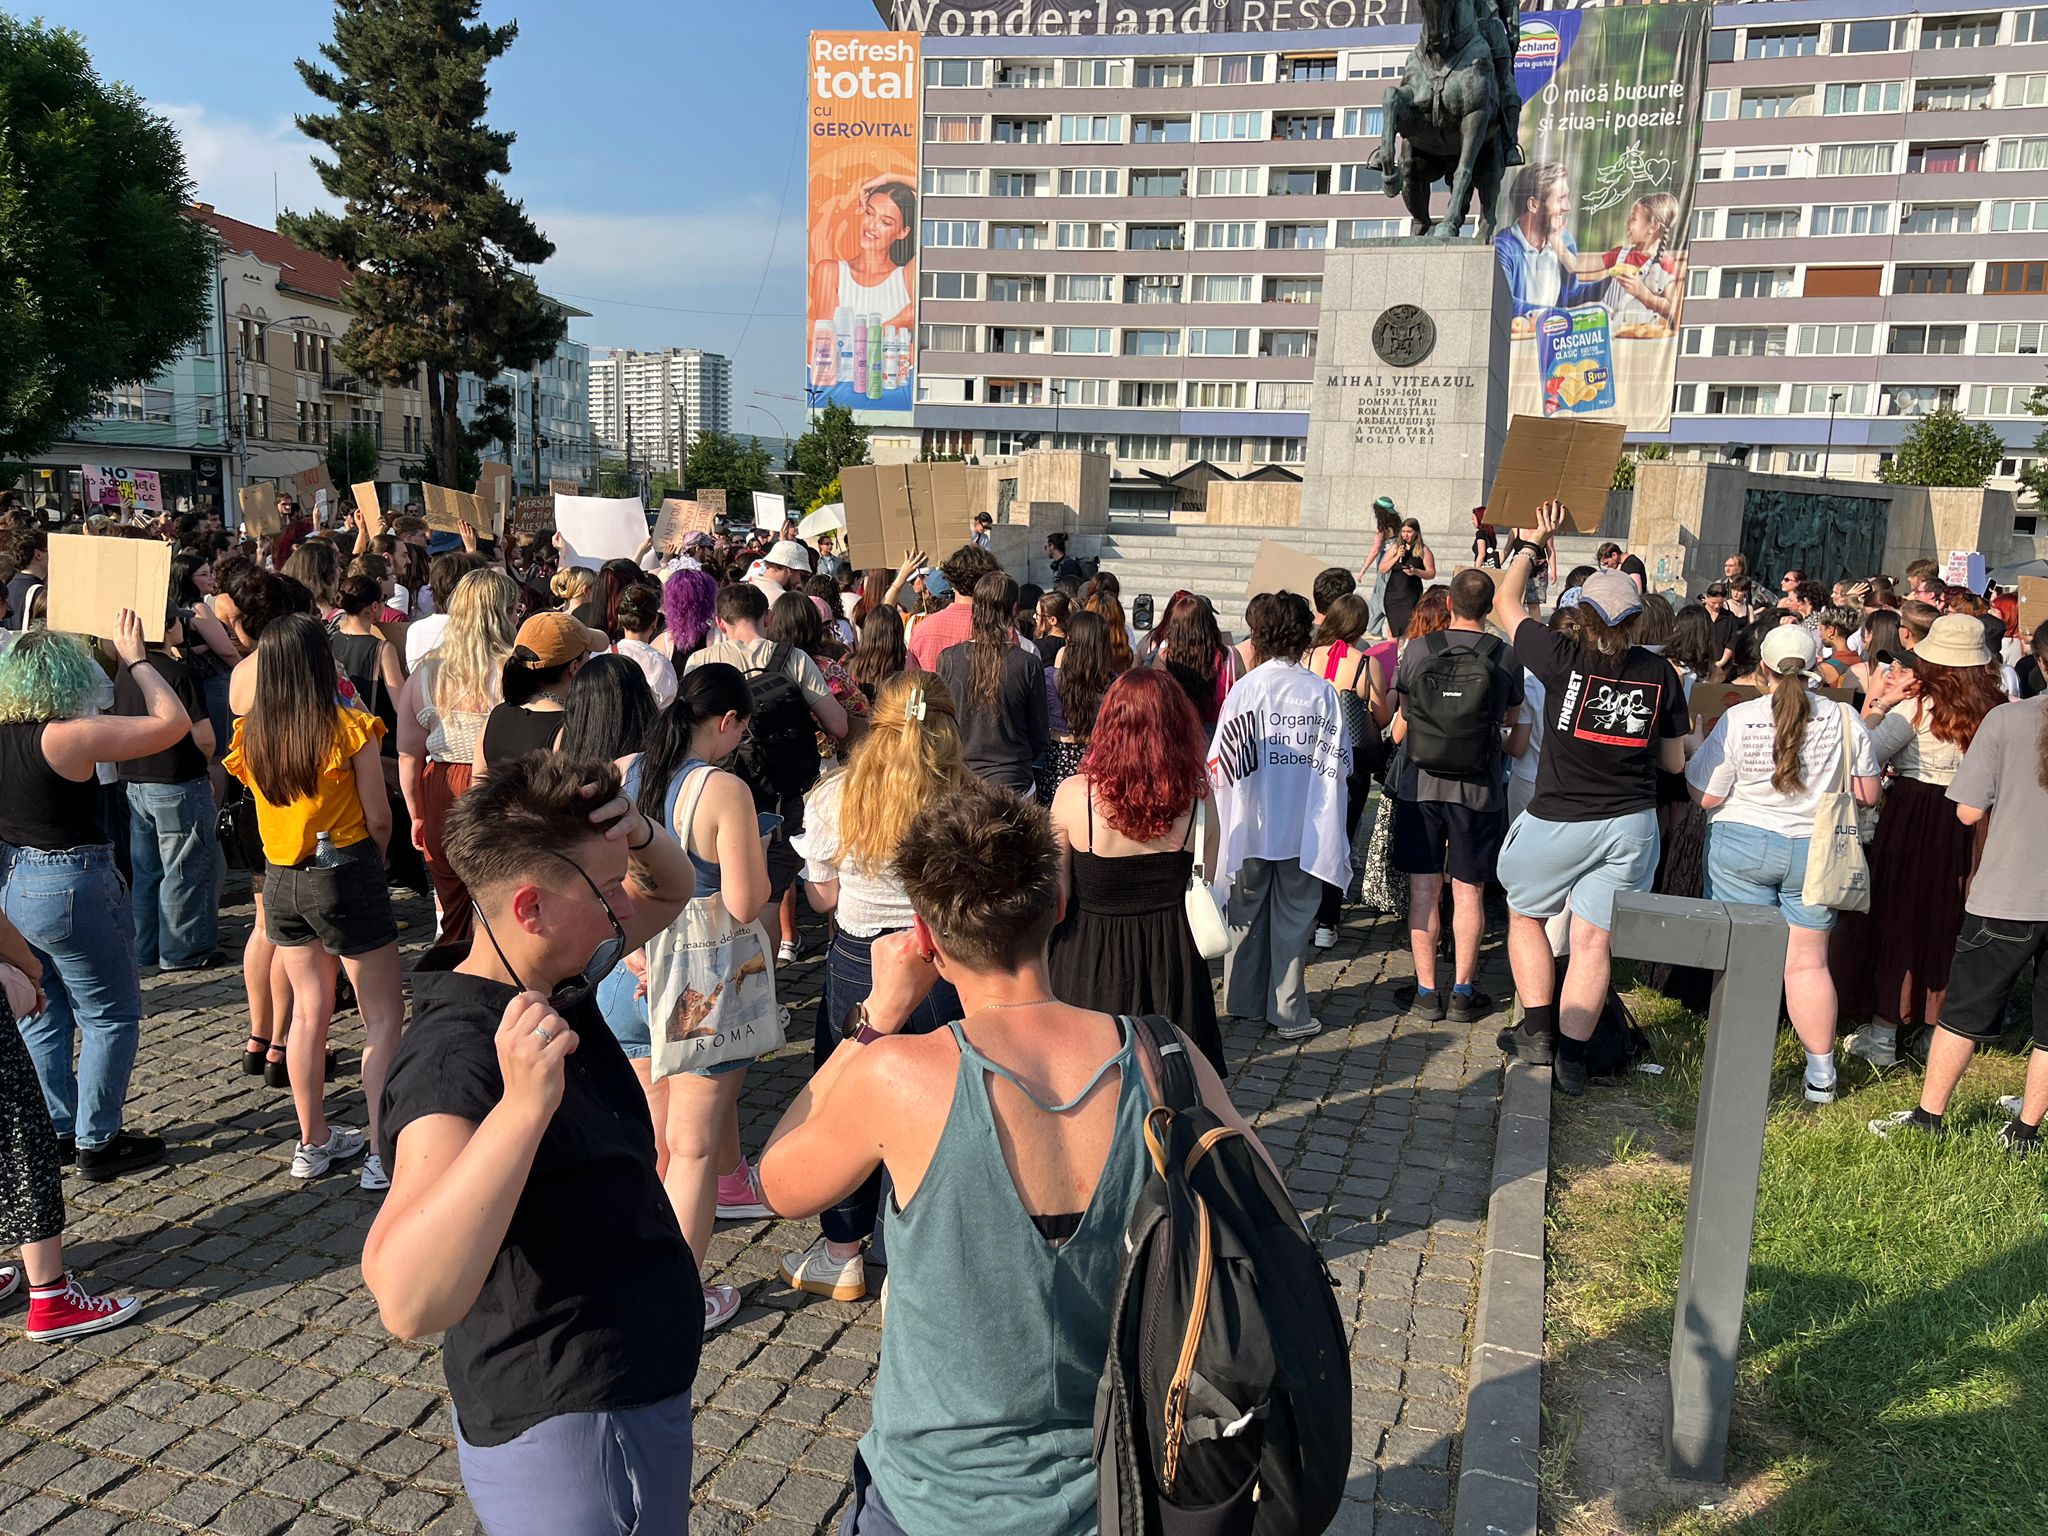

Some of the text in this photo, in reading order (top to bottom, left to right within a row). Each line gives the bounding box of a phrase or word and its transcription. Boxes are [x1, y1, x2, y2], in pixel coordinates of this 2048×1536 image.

[815, 39, 914, 62] Refresh
[814, 62, 914, 99] total
[1543, 79, 1684, 105] O mică bucurie
[814, 106, 832, 116] cu
[1537, 104, 1684, 138] și ziua-i poezie!
[813, 120, 911, 138] GEROVITAL
[1326, 375, 1475, 388] MIHAI VITEAZUL
[1588, 371, 1595, 383] 8
[1375, 388, 1422, 396] 1593-1601
[1358, 398, 1390, 406] DOMN
[1393, 398, 1406, 406] AL
[1423, 408, 1437, 416] AL
[1356, 416, 1423, 426] ARDEALULUI
[1356, 426, 1363, 434] A
[1355, 435, 1435, 445] MOLDOVEI
[101, 466, 128, 480] NO
[86, 475, 156, 491] is a complete
[99, 488, 155, 501] sentence
[1557, 670, 1583, 732] TINERET
[1269, 732, 1291, 745] din
[695, 1023, 755, 1051] ROMA
